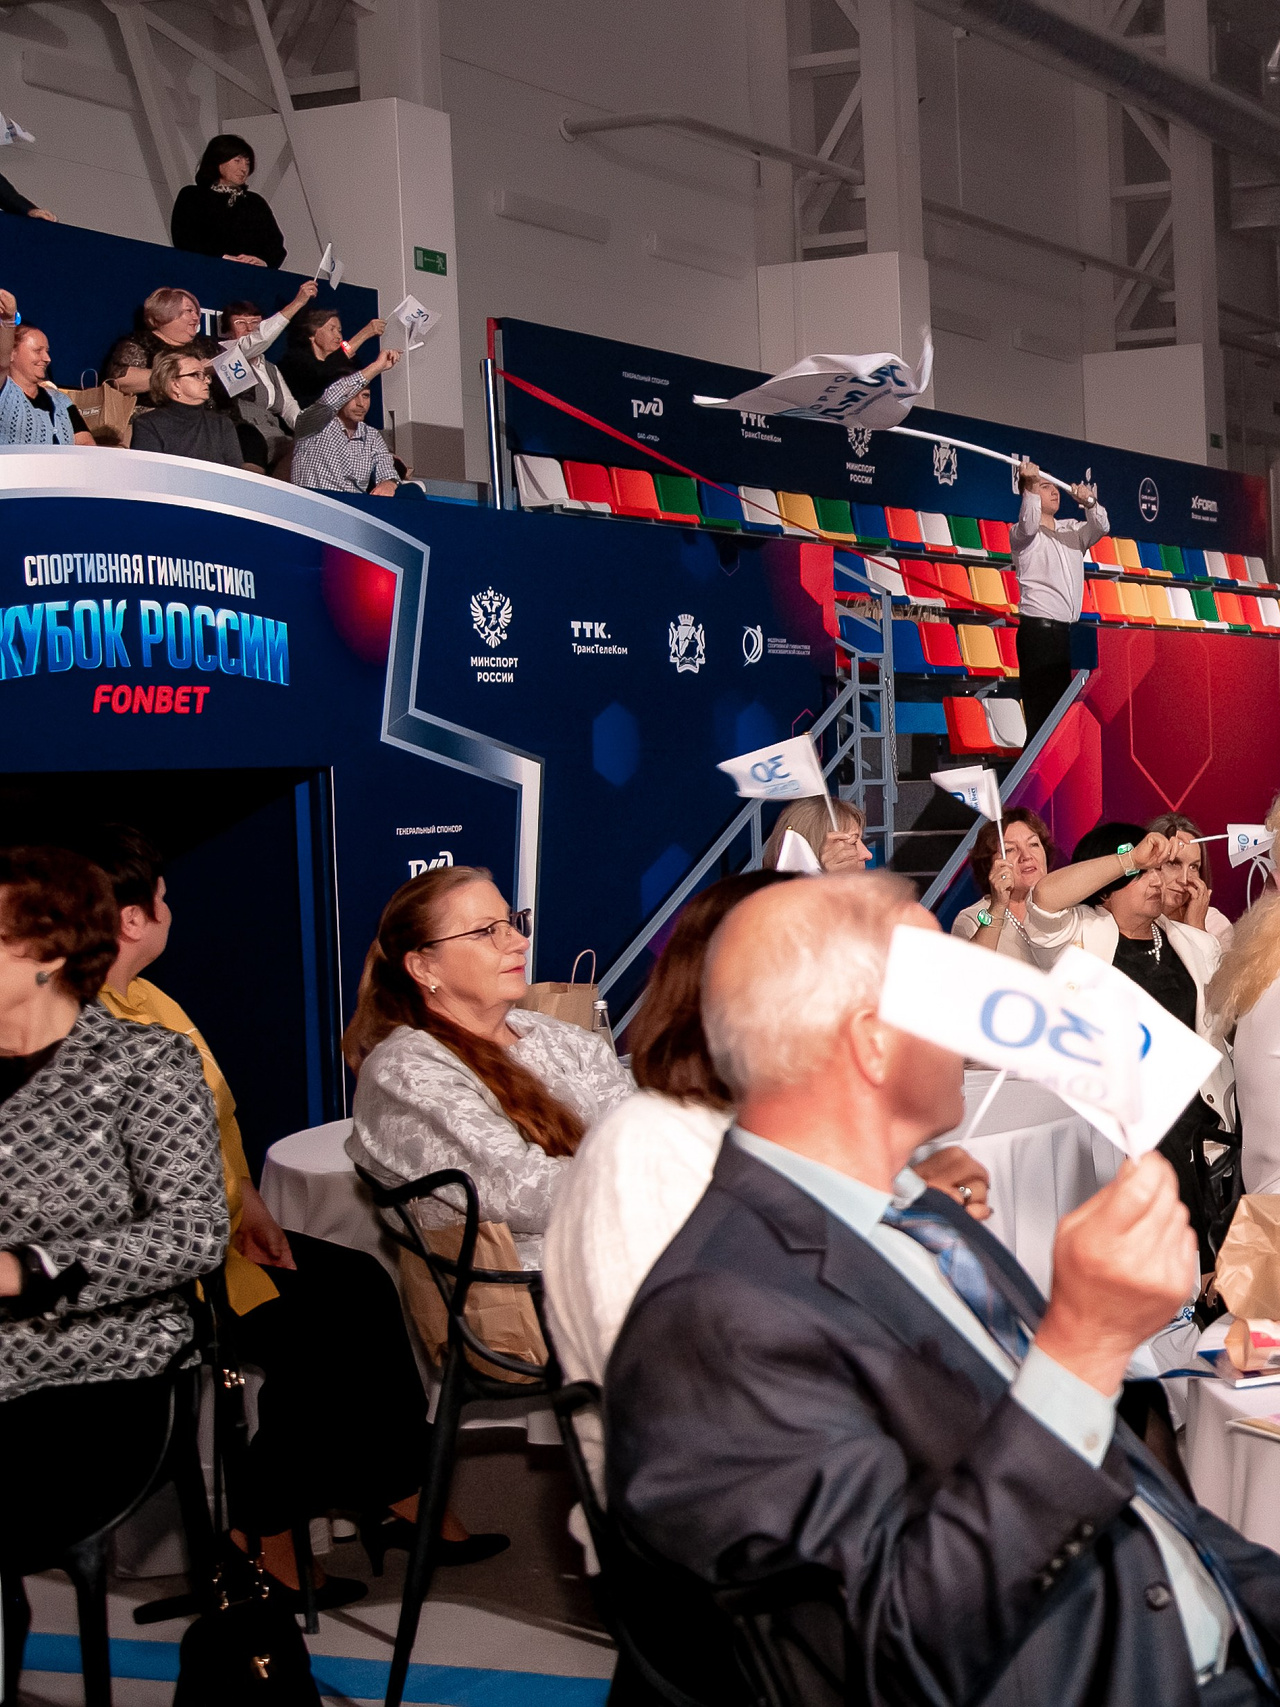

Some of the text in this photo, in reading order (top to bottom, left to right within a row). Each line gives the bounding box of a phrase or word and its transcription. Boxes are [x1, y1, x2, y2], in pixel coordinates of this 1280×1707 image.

[229, 359, 247, 379] 30
[846, 462, 876, 474] МИНСПОРТ
[850, 473, 873, 485] РОССИИ
[24, 553, 256, 599] СПОРТИВНАЯ ГИМНАСТИКА
[139, 599, 290, 686] РОССИИ
[571, 642, 628, 655] ТрансТелеКом
[470, 656, 519, 668] МИНСПОРТ
[477, 672, 514, 683] РОССИИ
[92, 684, 210, 714] FONBET
[396, 820, 463, 836] ГЕНЕРАЛЬНЫЙ СПОНСОР
